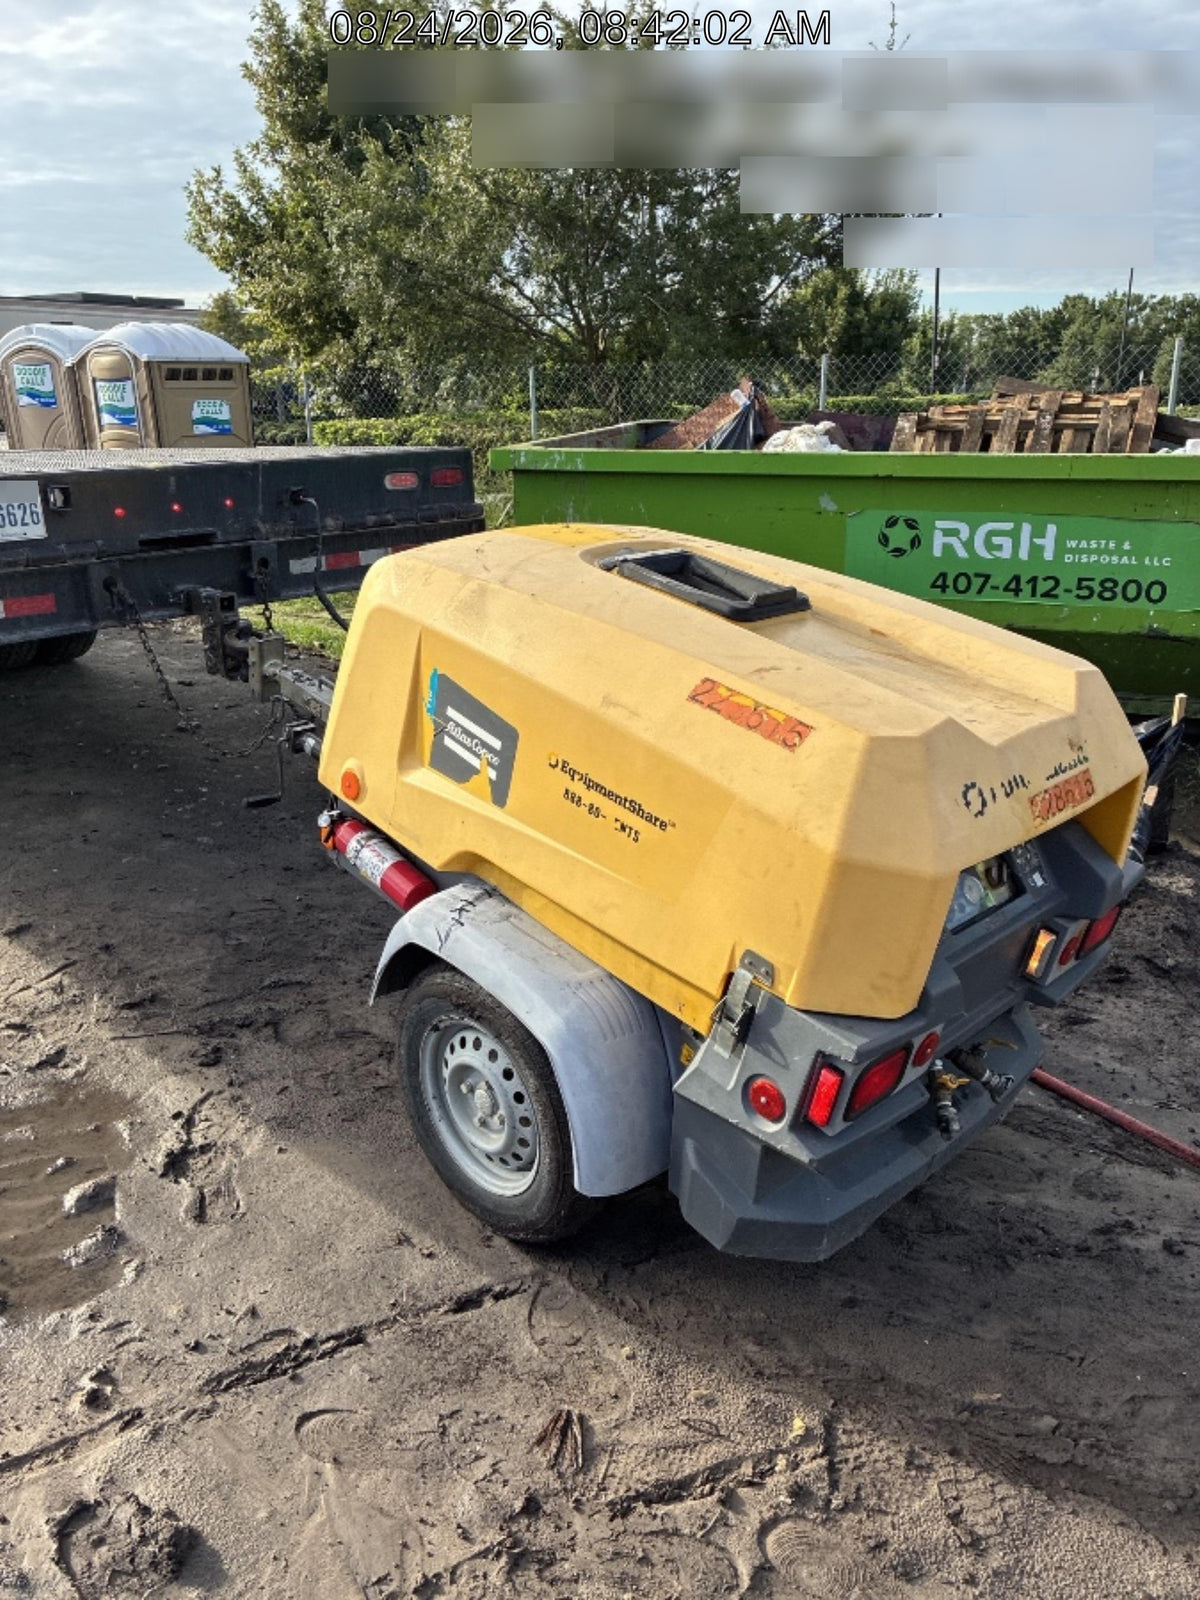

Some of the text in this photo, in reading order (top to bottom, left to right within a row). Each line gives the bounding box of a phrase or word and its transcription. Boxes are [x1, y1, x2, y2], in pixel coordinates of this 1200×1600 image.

[932, 519, 1057, 561] RGH
[1066, 540, 1132, 551] WASTE &
[1064, 554, 1172, 567] DISPOSAL LLC
[929, 571, 1168, 605] 407-412-5800
